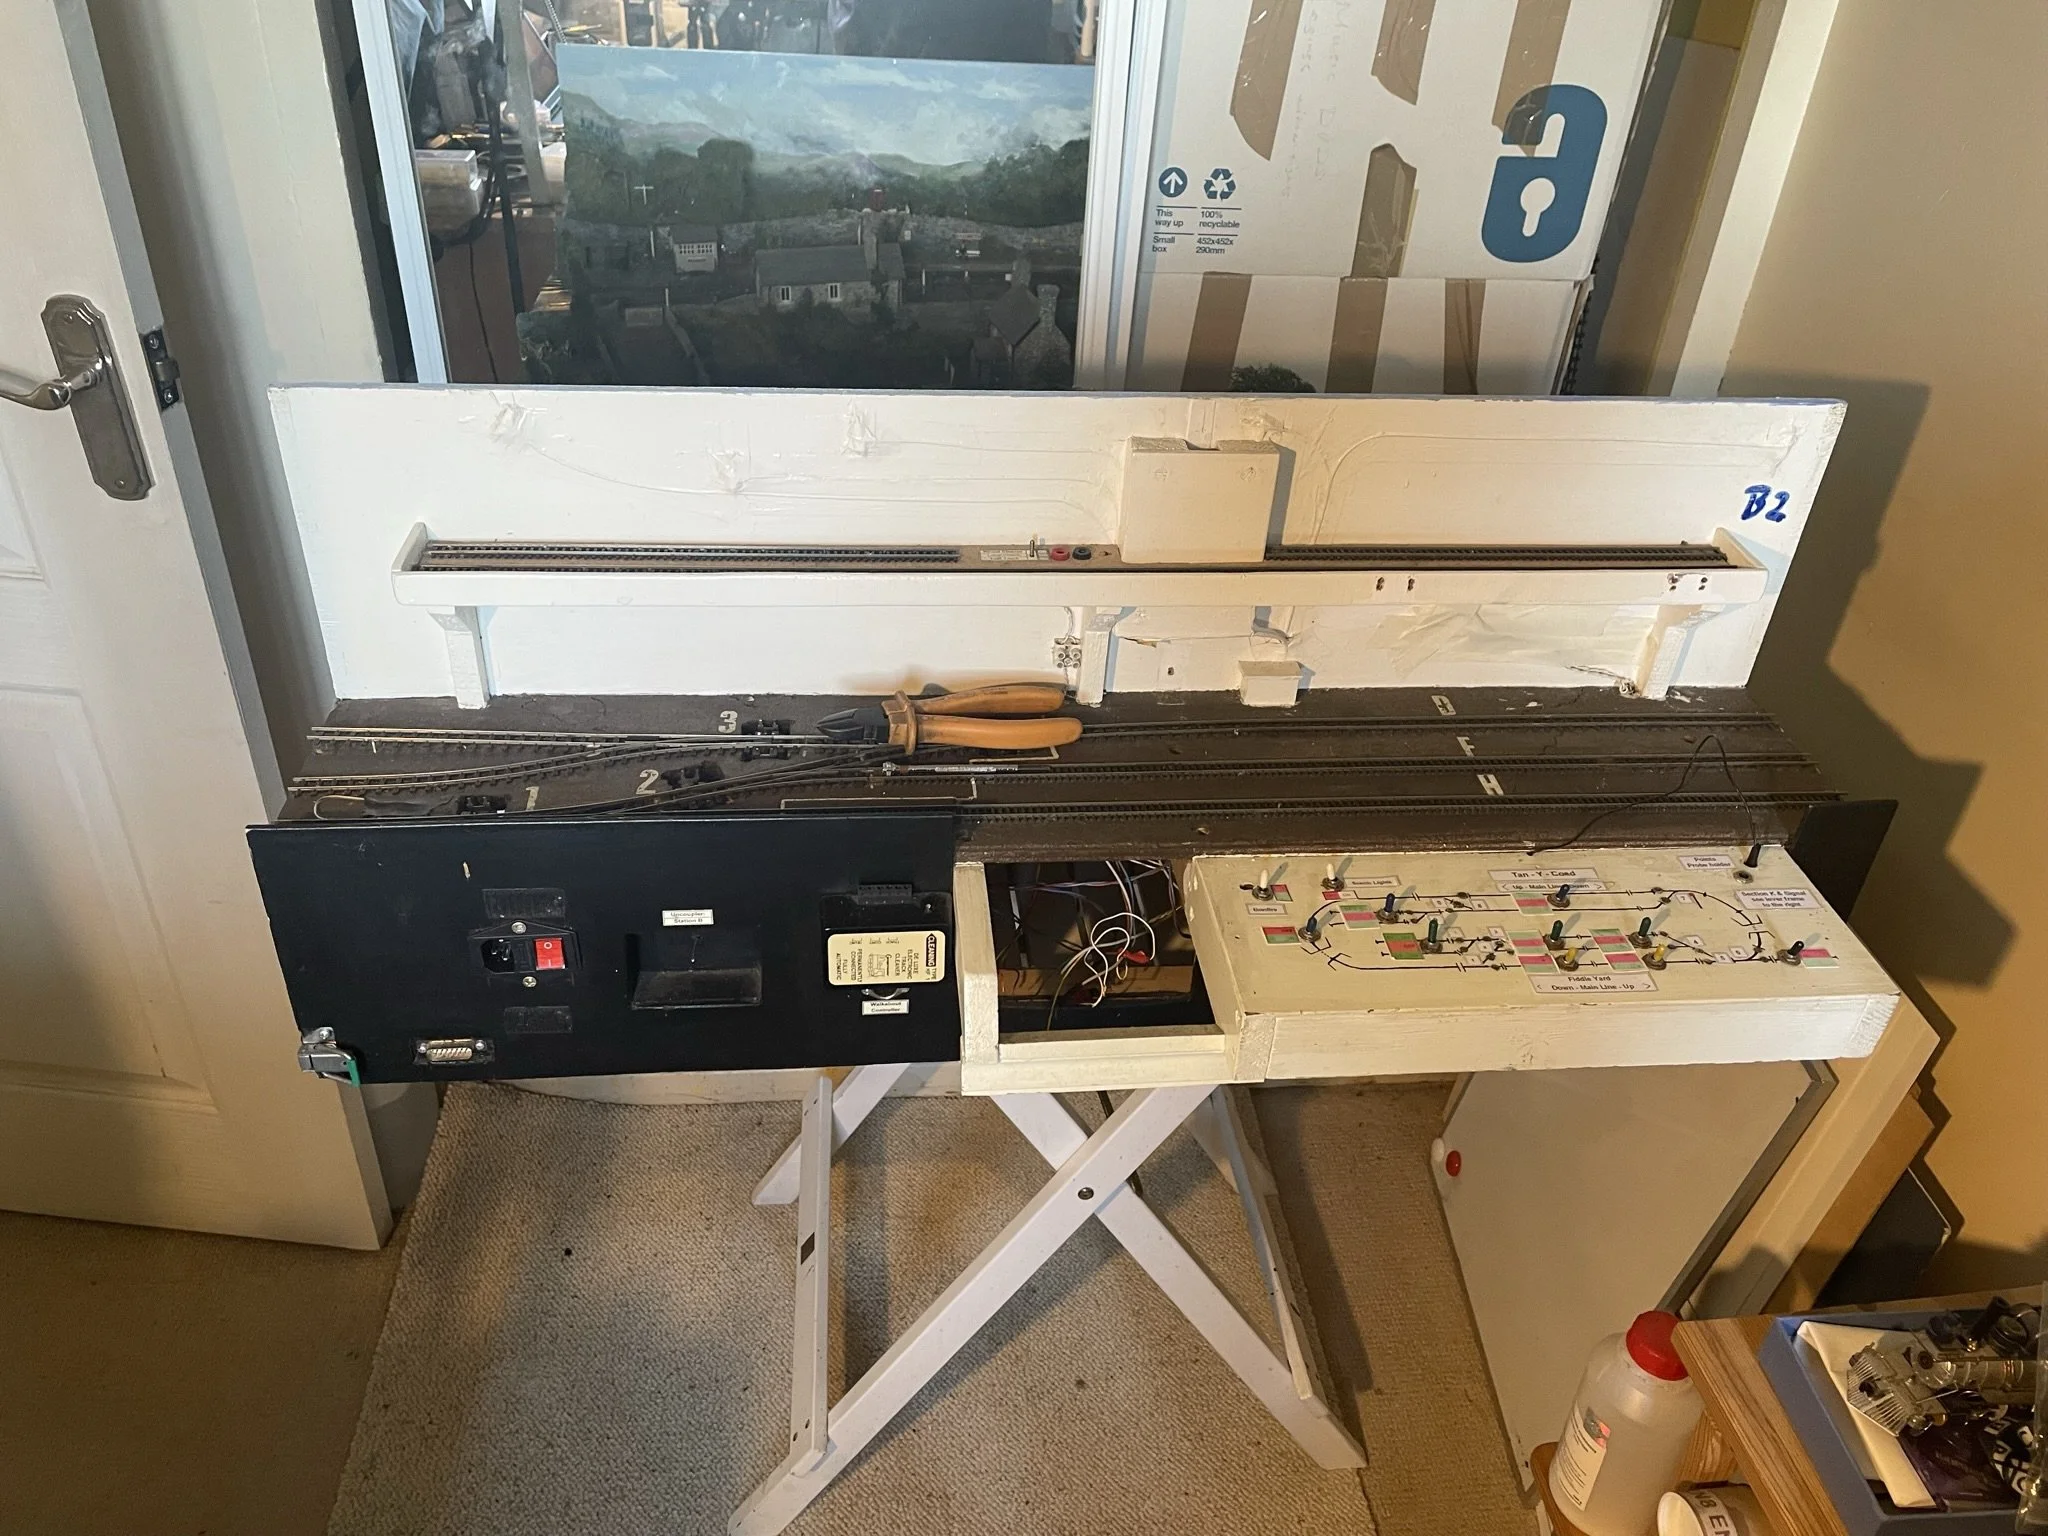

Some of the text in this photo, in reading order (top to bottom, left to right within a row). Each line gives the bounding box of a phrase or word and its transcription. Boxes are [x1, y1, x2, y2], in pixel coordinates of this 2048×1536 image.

[1156, 209, 1173, 217] This
[1199, 220, 1240, 228] recyclable
[1201, 211, 1223, 219] 100%
[1153, 236, 1176, 244] Small
[1196, 246, 1225, 254] 290mm
[1197, 237, 1234, 246] 452x452x
[1741, 484, 1790, 523] B2
[718, 710, 738, 734] 3
[1456, 736, 1476, 758] F
[635, 769, 660, 795] 2
[1476, 774, 1505, 797] H
[525, 786, 541, 811] 1
[927, 935, 936, 967] CLEANING
